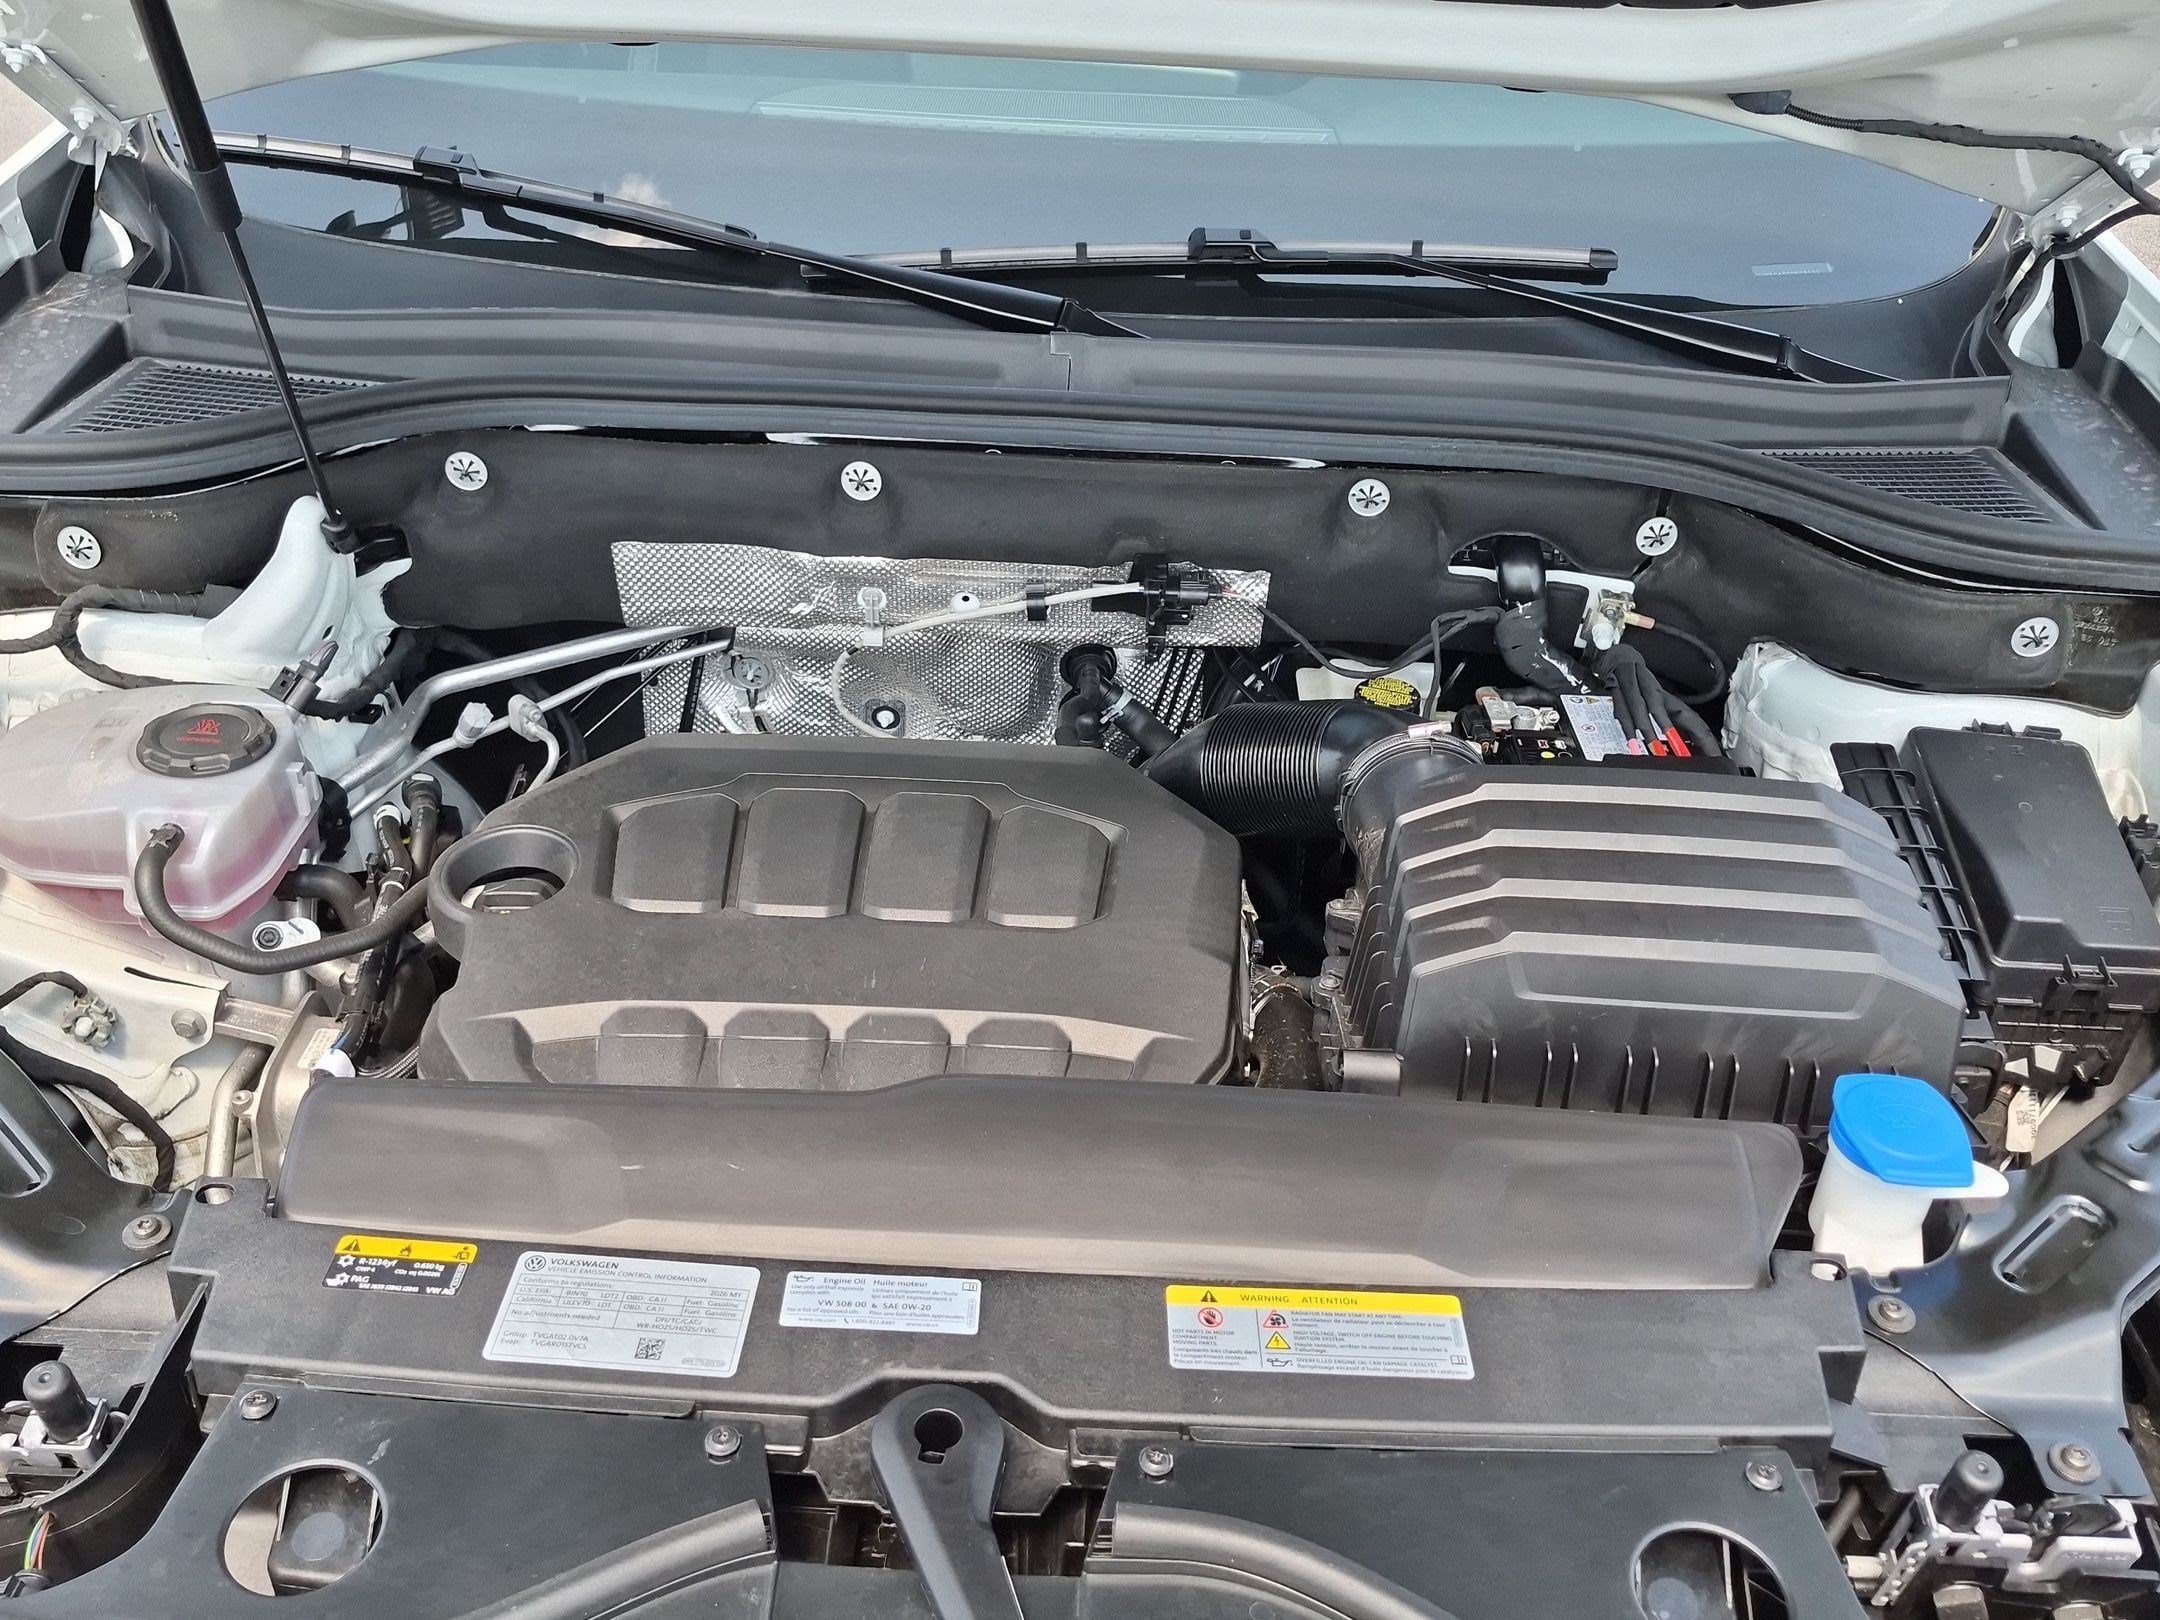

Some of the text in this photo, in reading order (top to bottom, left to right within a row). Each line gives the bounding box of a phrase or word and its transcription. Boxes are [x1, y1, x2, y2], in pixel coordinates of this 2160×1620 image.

[551, 1258, 619, 1269] VOLKSWAGEN
[548, 1266, 708, 1283] VEHICLE EMISSION CONTROL INFORMATION
[350, 1275, 370, 1283] PAG
[523, 1277, 559, 1285] Conforms
[824, 1277, 852, 1285] Engine
[873, 1279, 896, 1287] Huile
[1240, 1294, 1358, 1305] WARNING ATTENTION
[707, 1301, 739, 1309] Gasoline
[836, 1300, 853, 1308] 508
[705, 1309, 737, 1317] Gasoline
